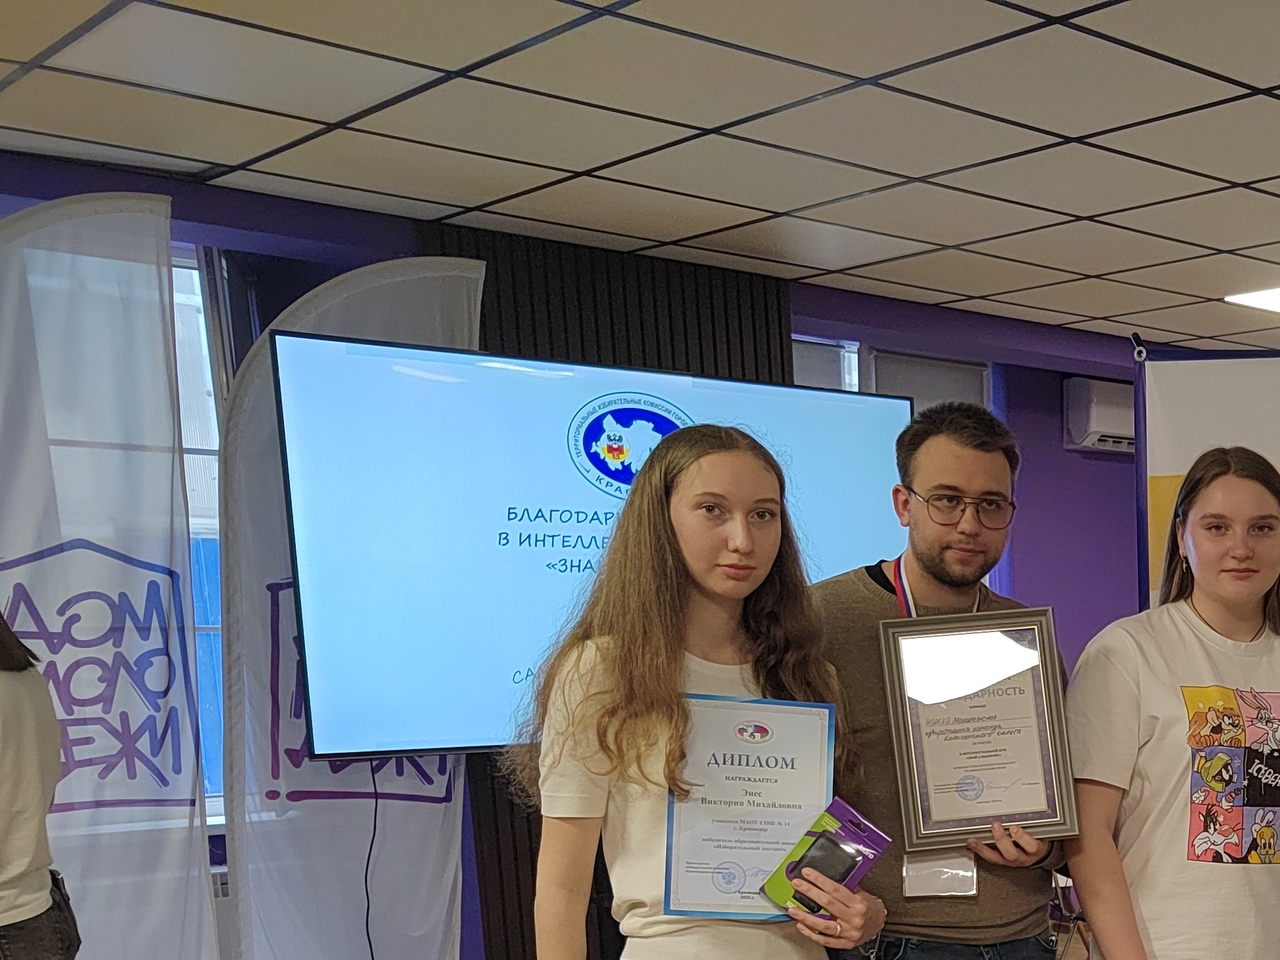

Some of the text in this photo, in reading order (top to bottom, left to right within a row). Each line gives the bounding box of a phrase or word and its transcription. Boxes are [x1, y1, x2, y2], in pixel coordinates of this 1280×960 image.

[671, 411, 689, 427] ГОРОД
[506, 506, 615, 526] БЛАГОДАР
[497, 531, 609, 550] В ИНТЕЛЛЕ
[545, 558, 596, 574] «ЗНА
[57, 705, 183, 789] ЕЖИ
[706, 752, 799, 770] ДИПЛОМ
[724, 775, 779, 784] НАГРАЖДАЕТСЯ
[700, 797, 802, 810] Виктория Михайловна
